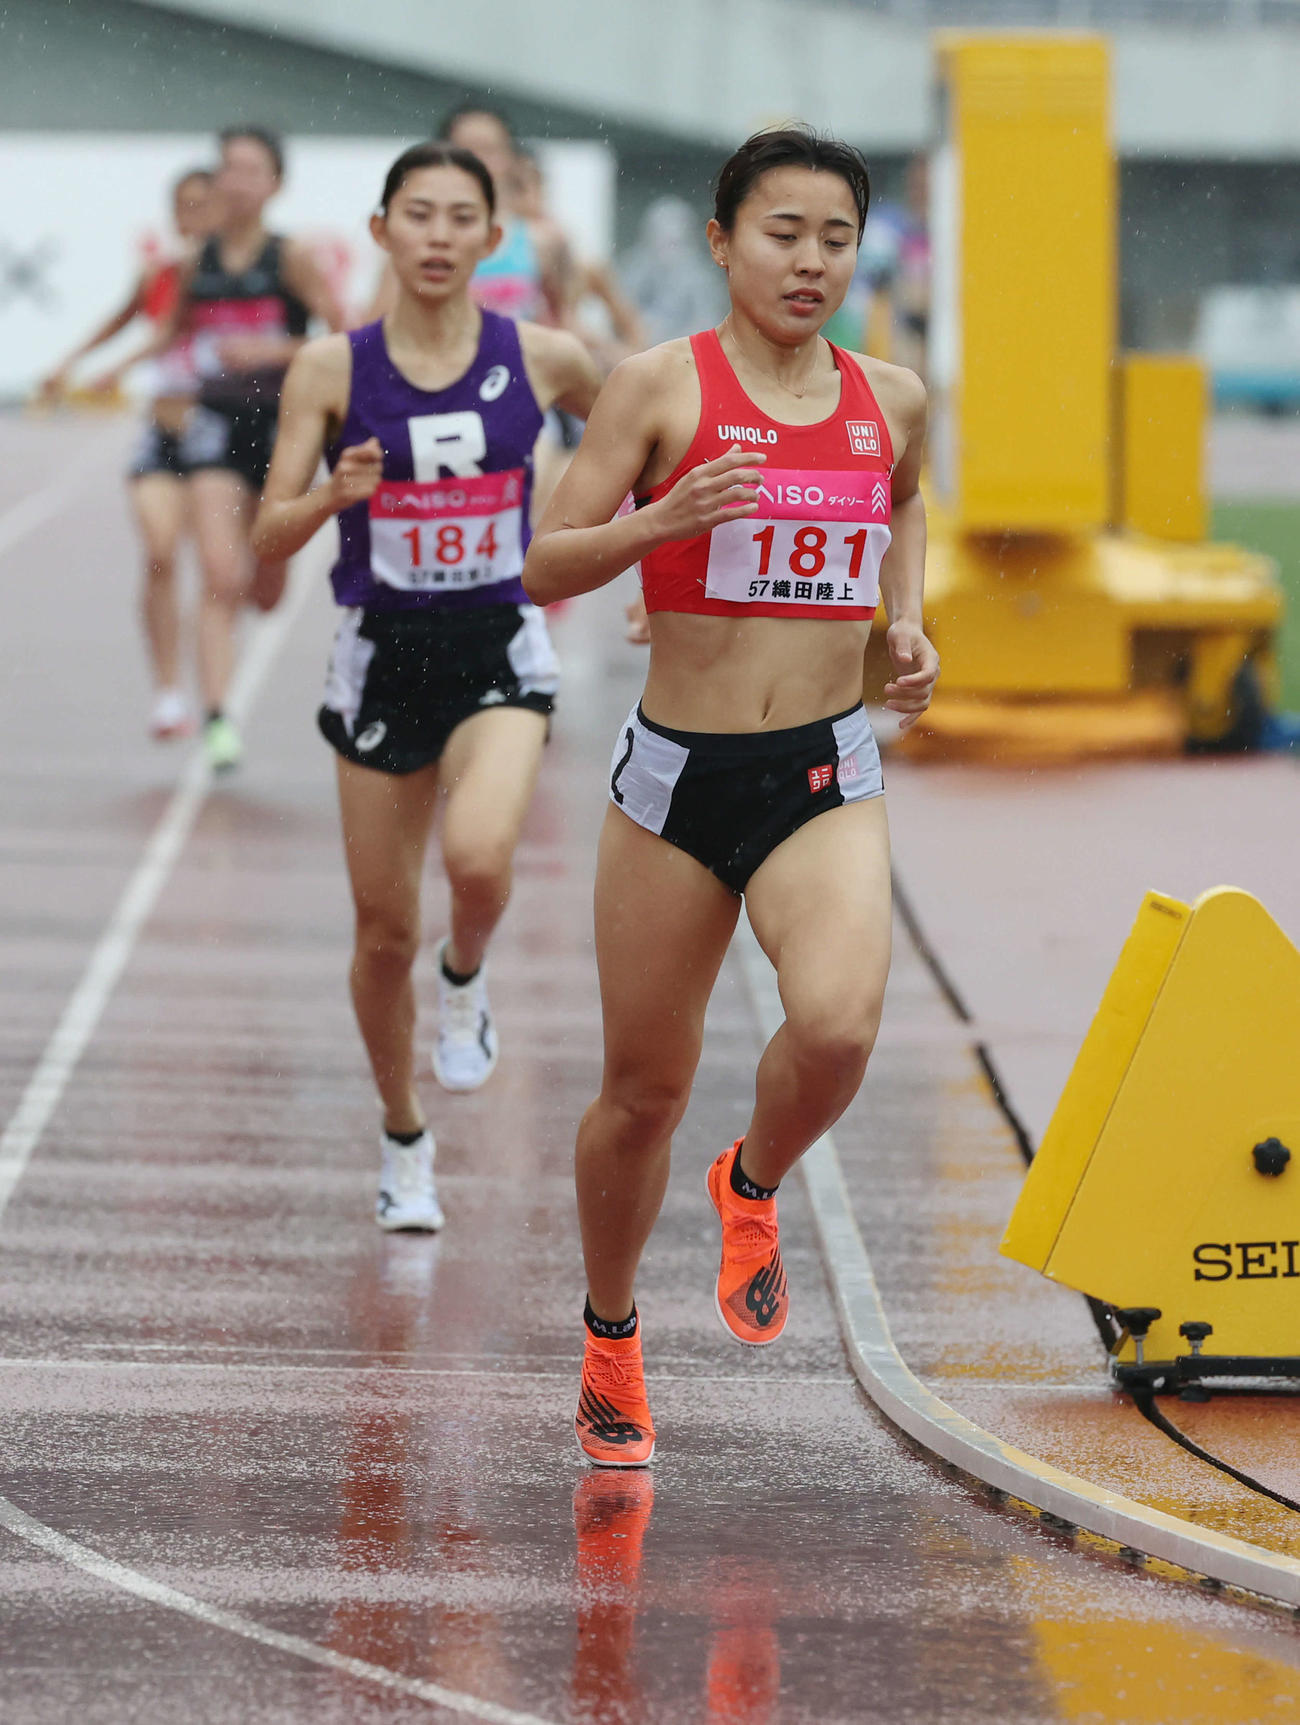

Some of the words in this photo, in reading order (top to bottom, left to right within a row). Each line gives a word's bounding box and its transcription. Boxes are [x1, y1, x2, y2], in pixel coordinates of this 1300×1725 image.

[717, 425, 778, 444] UNIQLO
[851, 426, 874, 437] UNI
[408, 411, 486, 484] R
[855, 438, 877, 451] QLO
[728, 484, 824, 506] AISO
[828, 496, 865, 506] ダイソー
[402, 522, 498, 567] 184
[752, 525, 867, 578] 181
[748, 579, 854, 601] 57織田陸上
